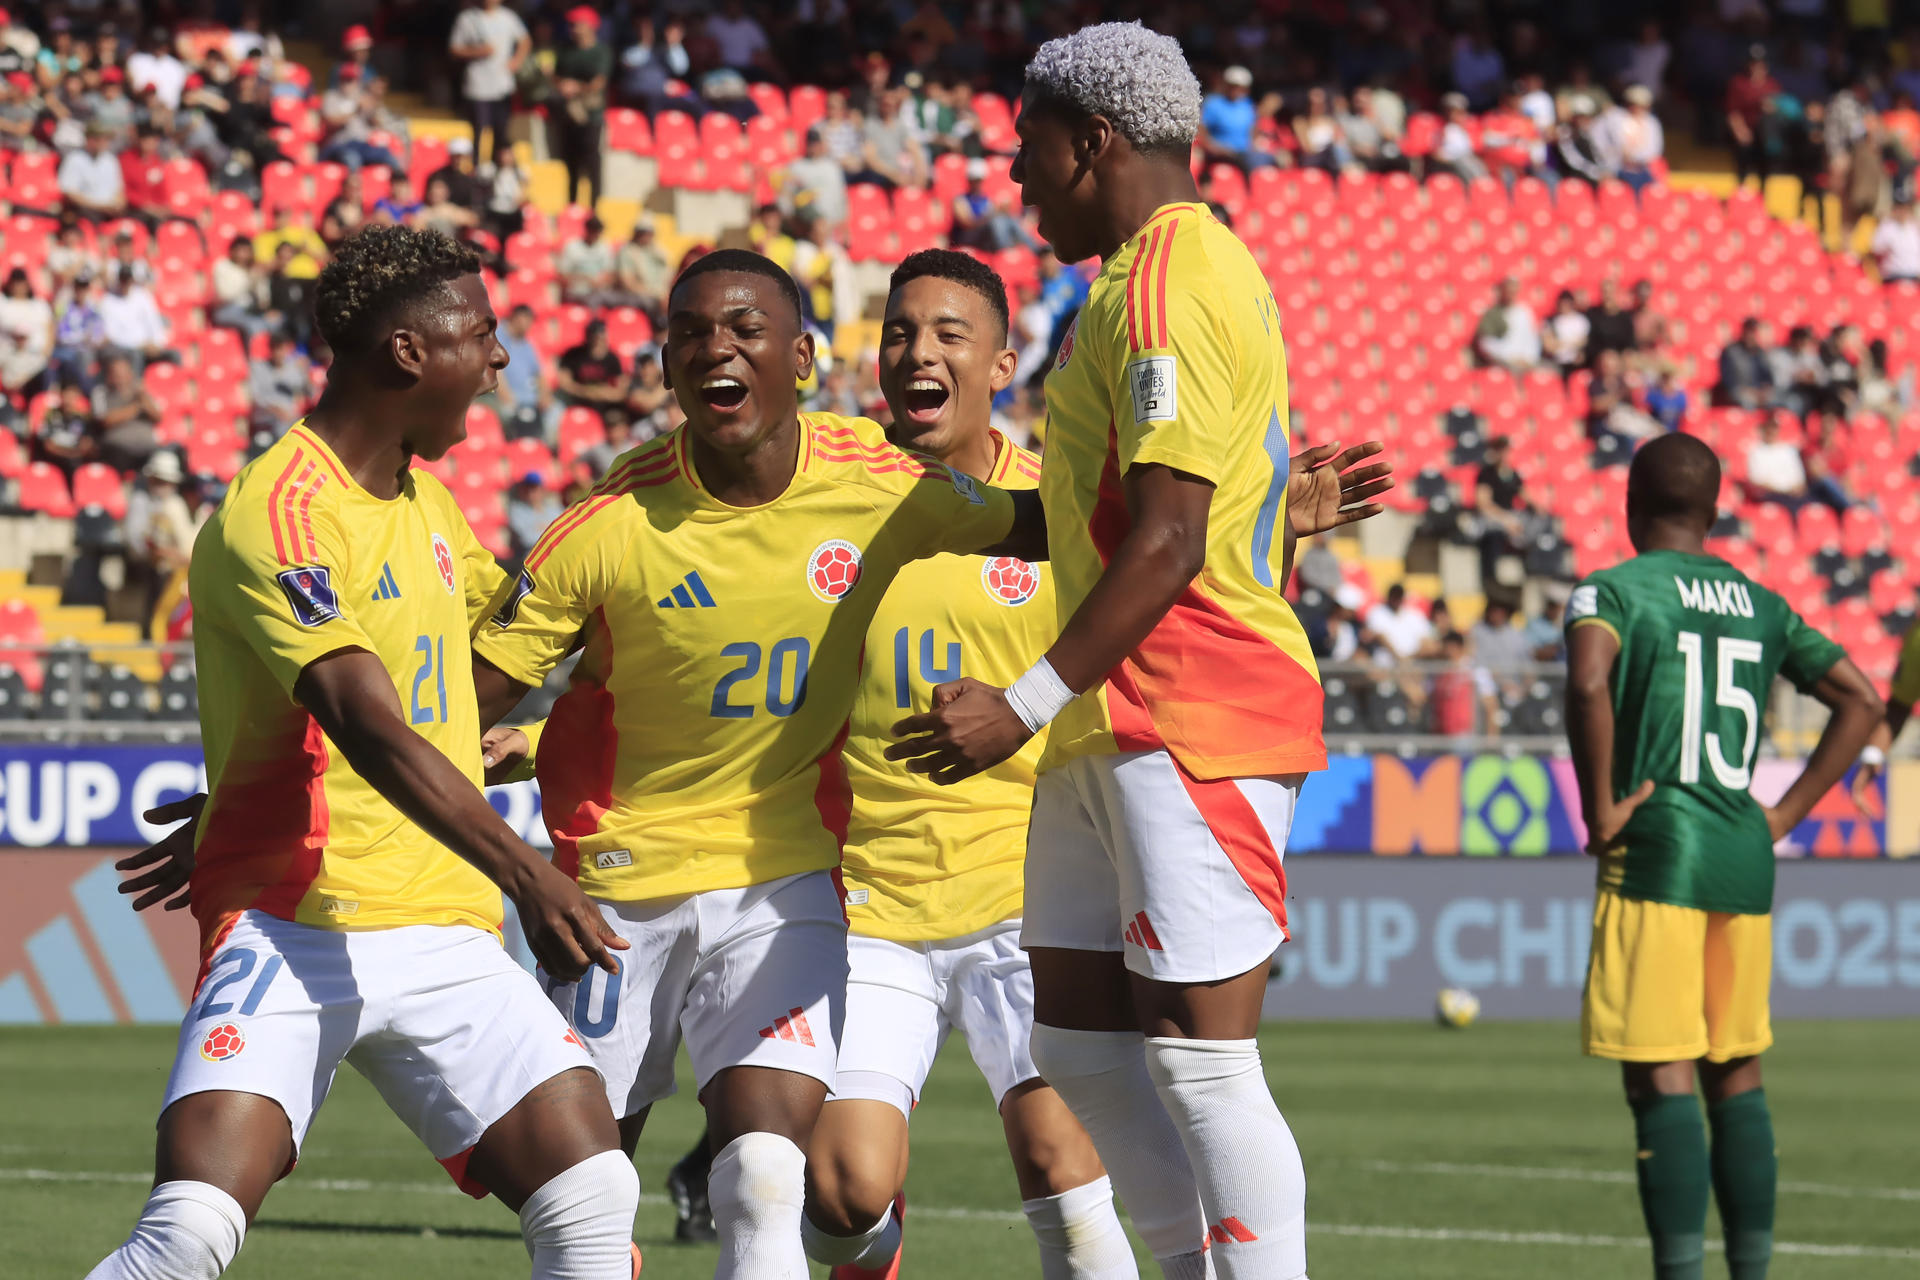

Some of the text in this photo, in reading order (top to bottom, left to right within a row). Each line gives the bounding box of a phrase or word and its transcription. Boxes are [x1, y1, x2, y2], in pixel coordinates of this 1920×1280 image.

[1139, 377, 1164, 391] UNITES
[1674, 574, 1754, 618] MAKU
[411, 633, 448, 725] 21
[710, 636, 811, 718] 20
[894, 626, 962, 708] 14
[1677, 630, 1763, 790] 15
[0, 760, 121, 846] UP
[196, 947, 285, 1021] 21
[1434, 898, 1593, 987] CHI
[547, 953, 625, 1038] 0
